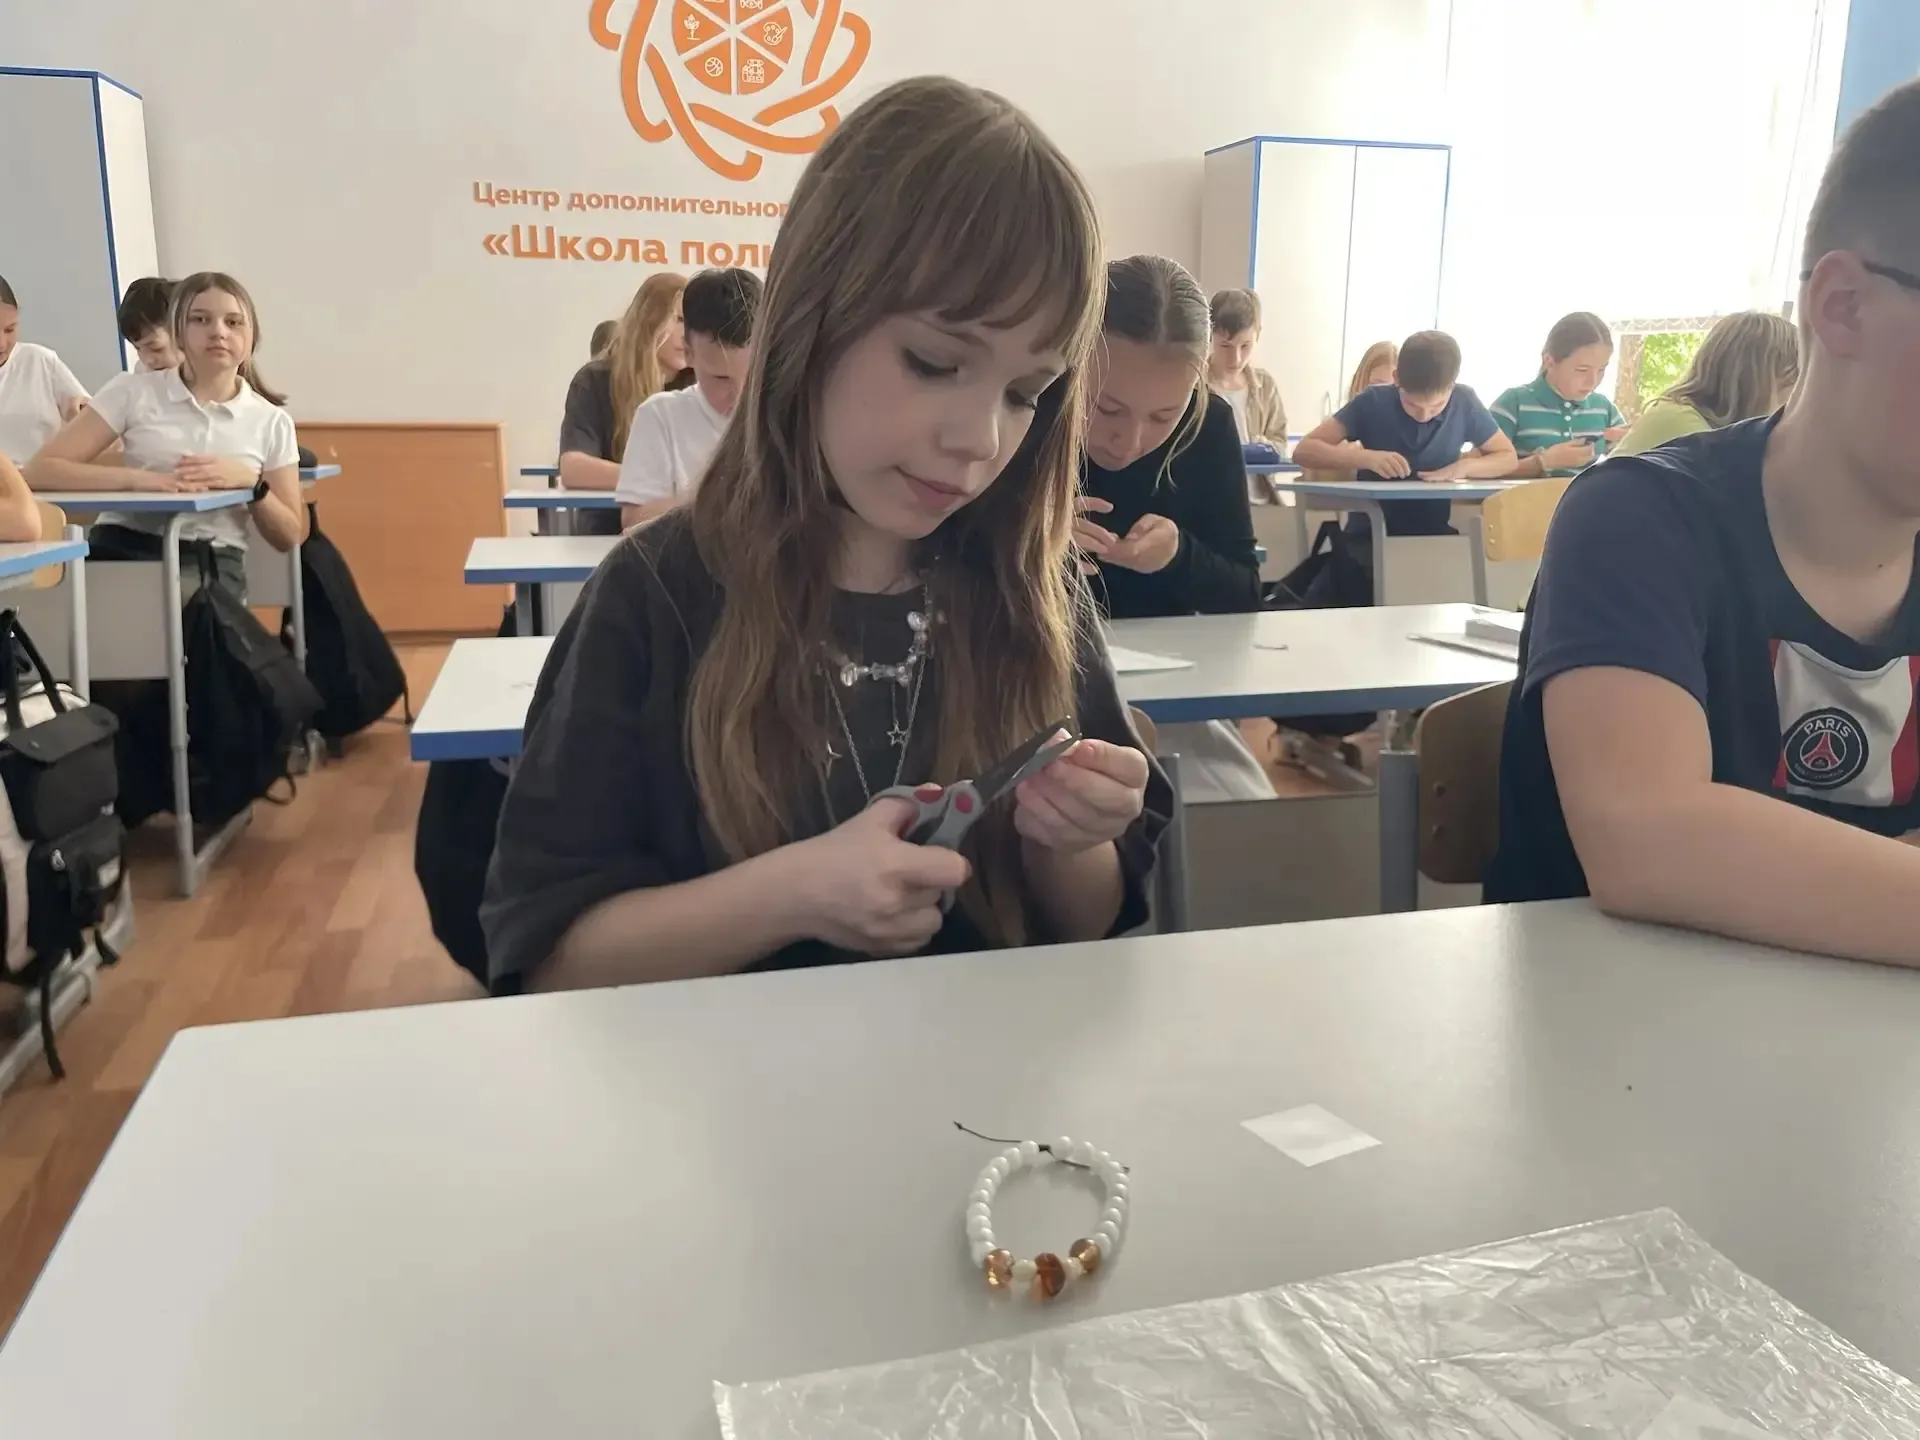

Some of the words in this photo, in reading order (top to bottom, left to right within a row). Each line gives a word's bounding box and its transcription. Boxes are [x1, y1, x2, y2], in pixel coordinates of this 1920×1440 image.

[473, 180, 560, 211] Центр
[482, 223, 668, 265] «Школа
[1803, 718, 1852, 738] PARIS
